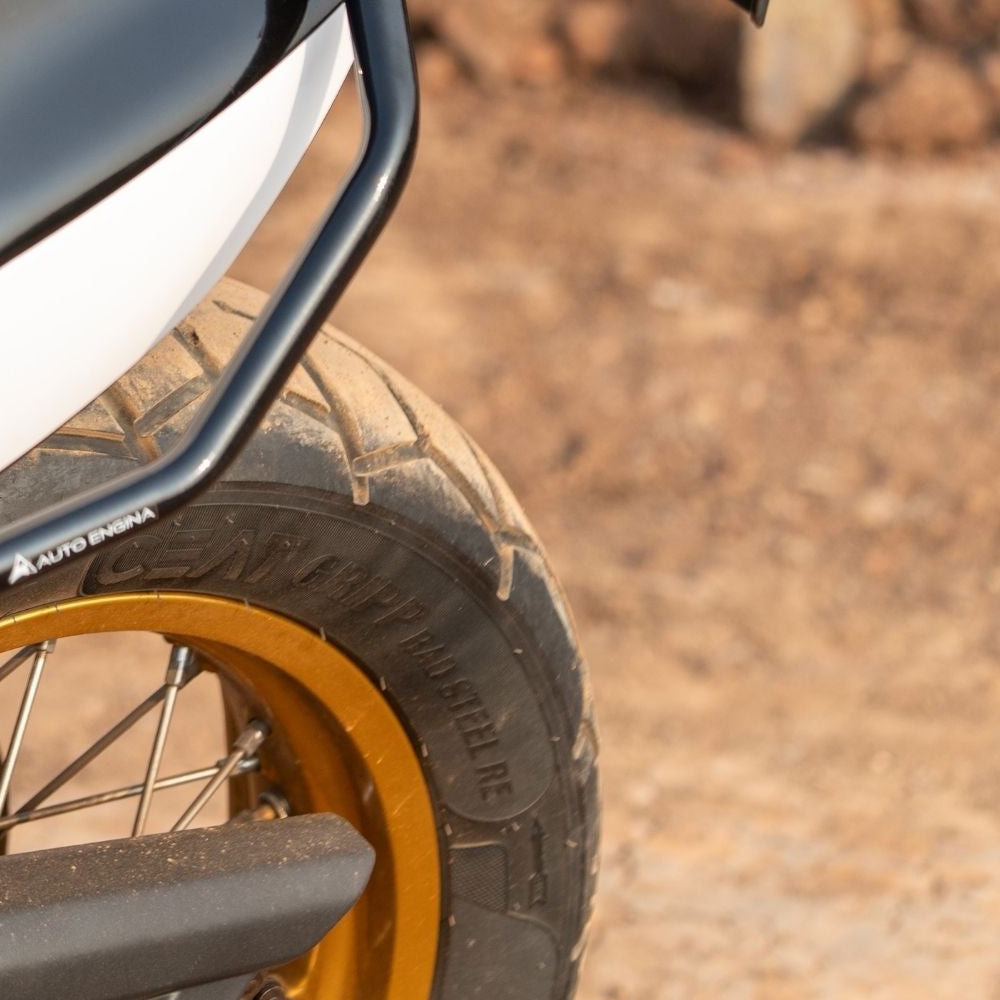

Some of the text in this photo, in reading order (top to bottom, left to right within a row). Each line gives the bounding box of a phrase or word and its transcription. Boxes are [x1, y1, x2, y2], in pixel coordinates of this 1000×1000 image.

[36, 536, 88, 571] AUTO
[87, 506, 156, 546] ENGINA
[96, 528, 311, 586] CEAT
